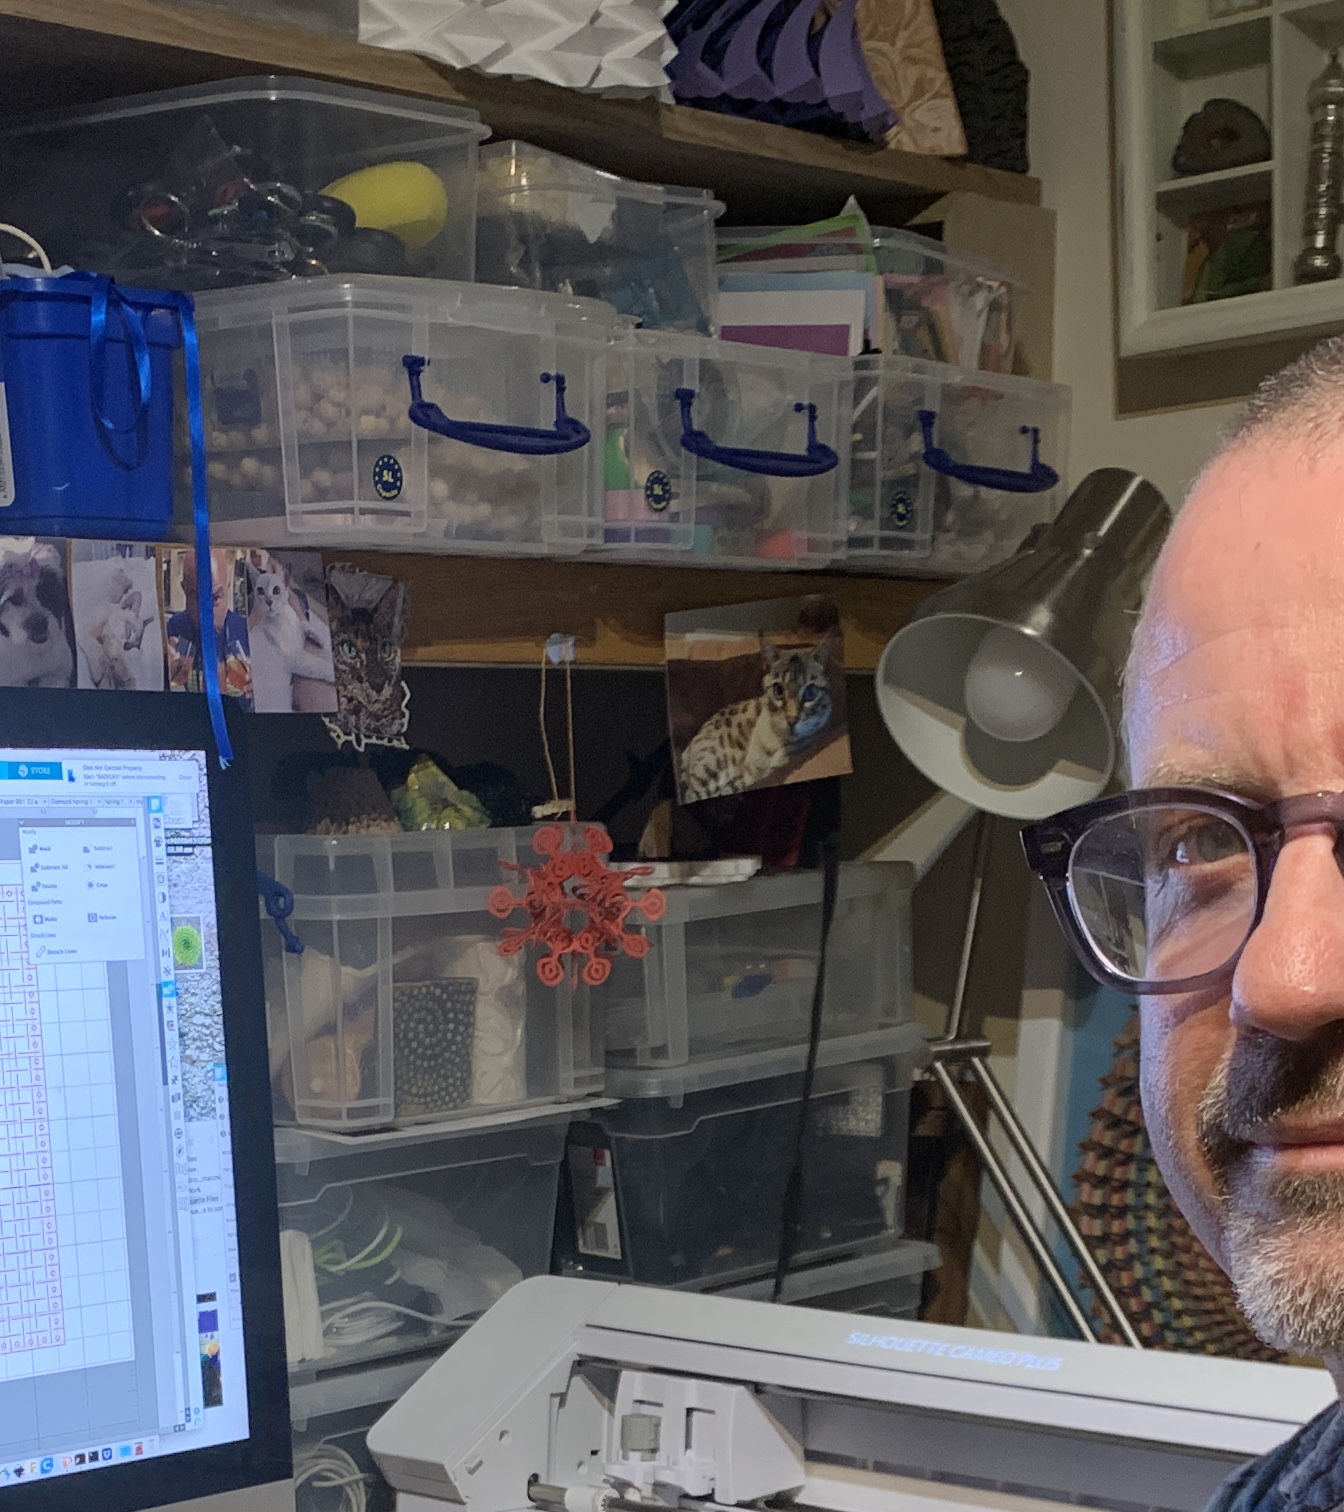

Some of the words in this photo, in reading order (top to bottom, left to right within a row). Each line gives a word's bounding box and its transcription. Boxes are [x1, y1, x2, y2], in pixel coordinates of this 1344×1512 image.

[30, 767, 51, 775] STORE
[845, 1330, 950, 1357] SILHOUETTE
[949, 1344, 1017, 1365] CAMEO
[1016, 1352, 1064, 1372] PLUS
